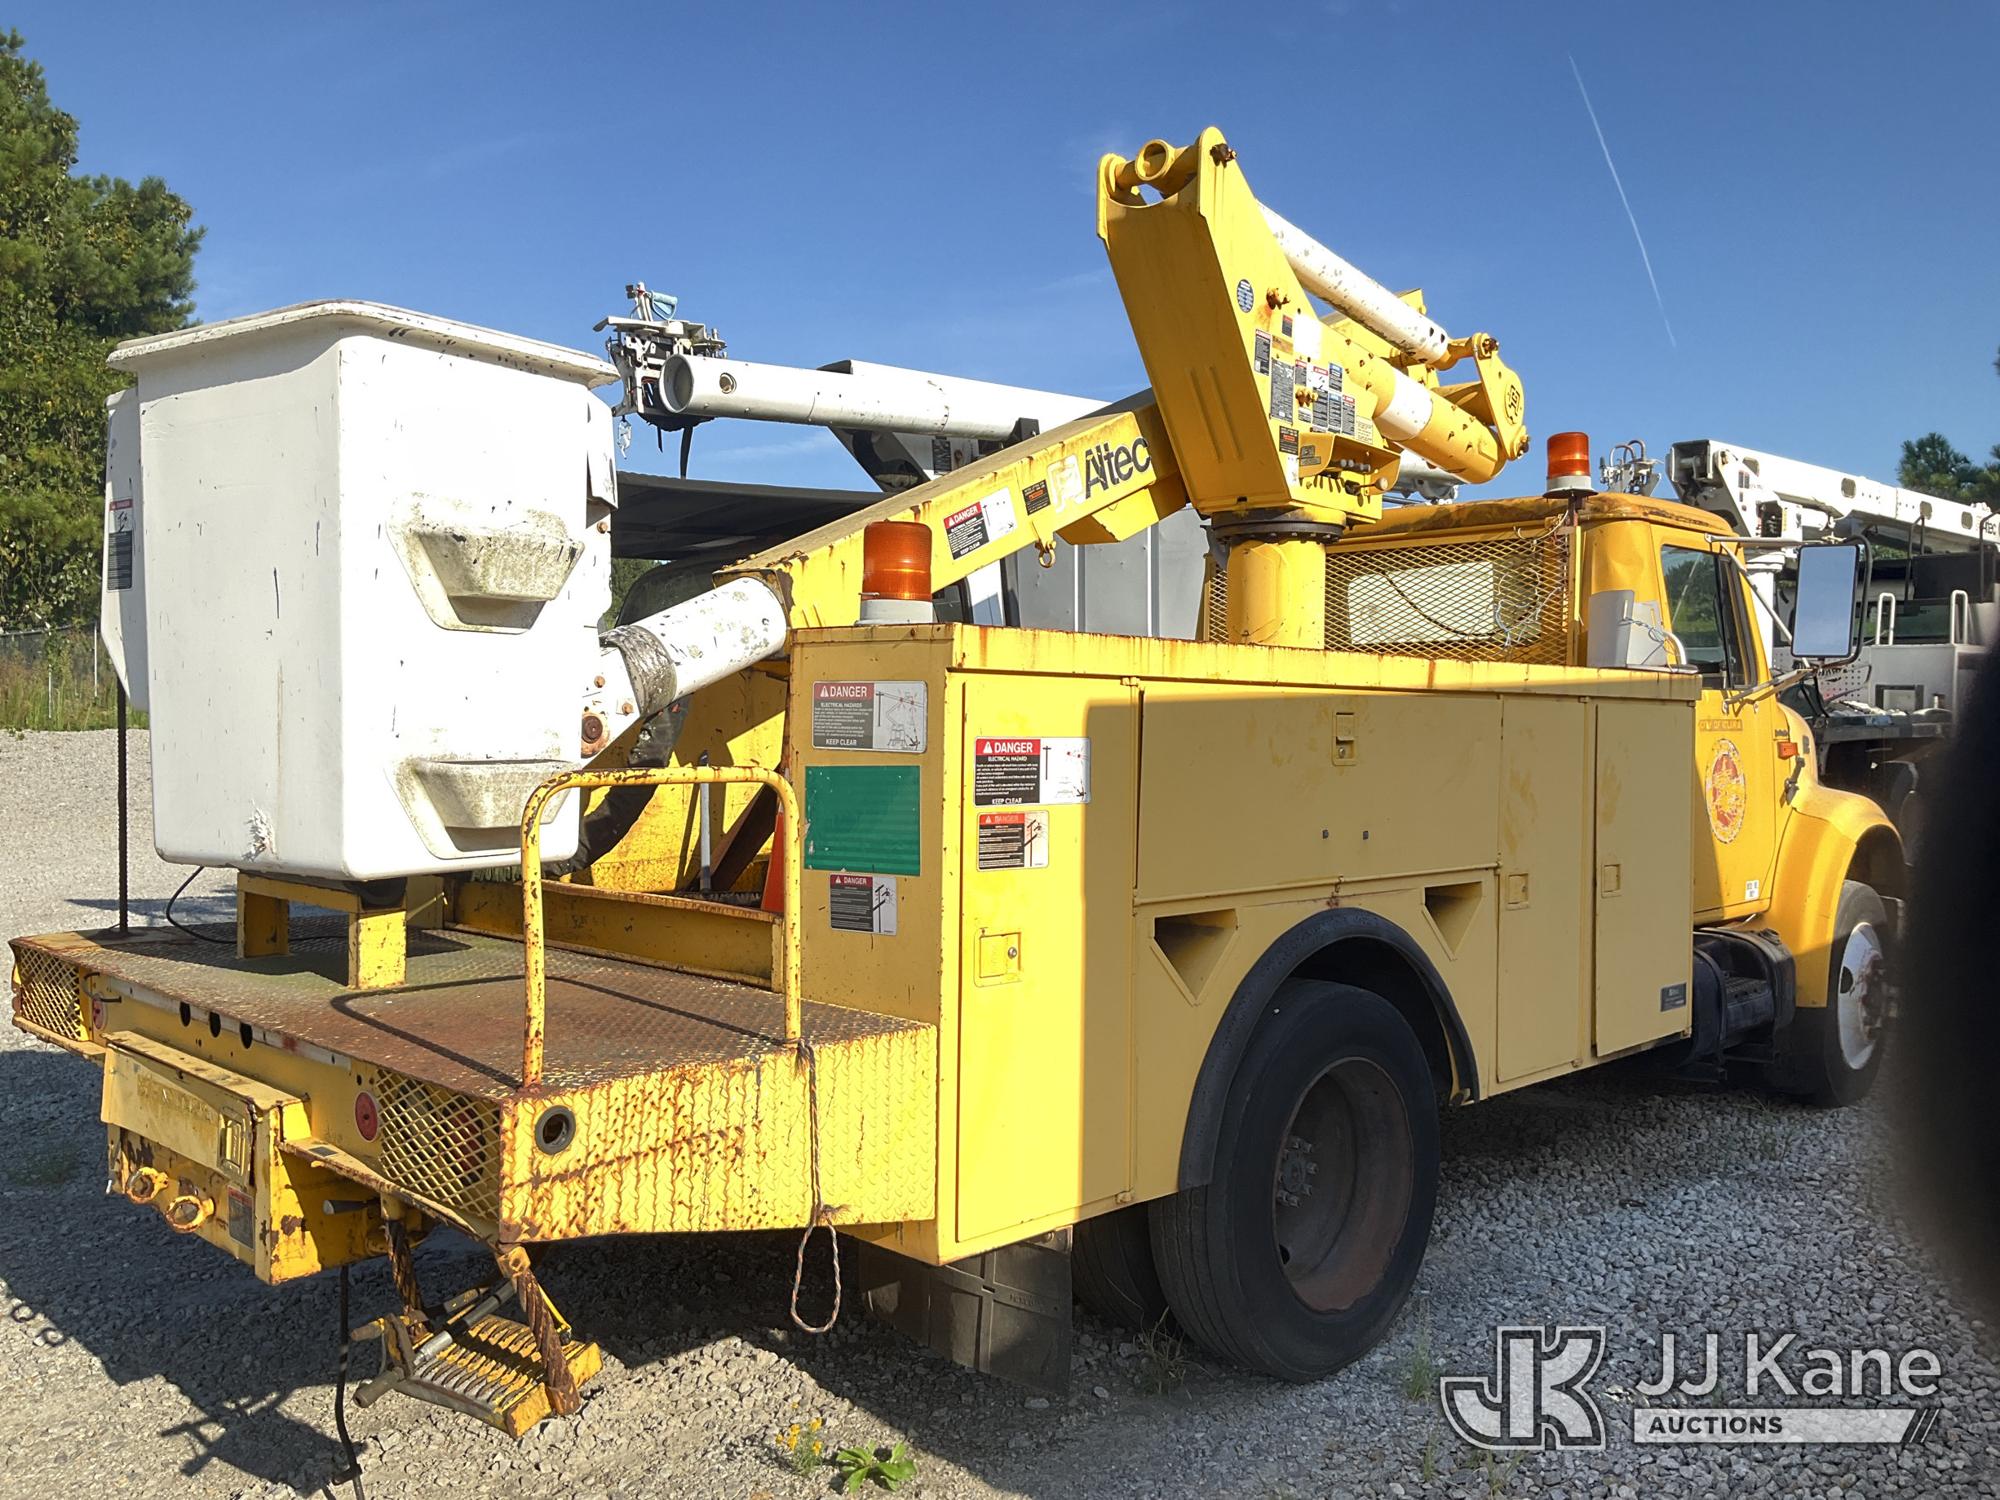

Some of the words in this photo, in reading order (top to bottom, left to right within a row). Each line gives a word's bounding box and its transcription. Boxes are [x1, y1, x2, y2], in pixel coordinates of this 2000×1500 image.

[1085, 437, 1152, 500] Altec
[954, 505, 979, 523] DANGER
[830, 685, 868, 698] DANGER
[825, 738, 839, 746] KEEP
[840, 738, 858, 746] CLEAR
[994, 741, 1033, 754] DANGER
[843, 876, 867, 885] DANGER
